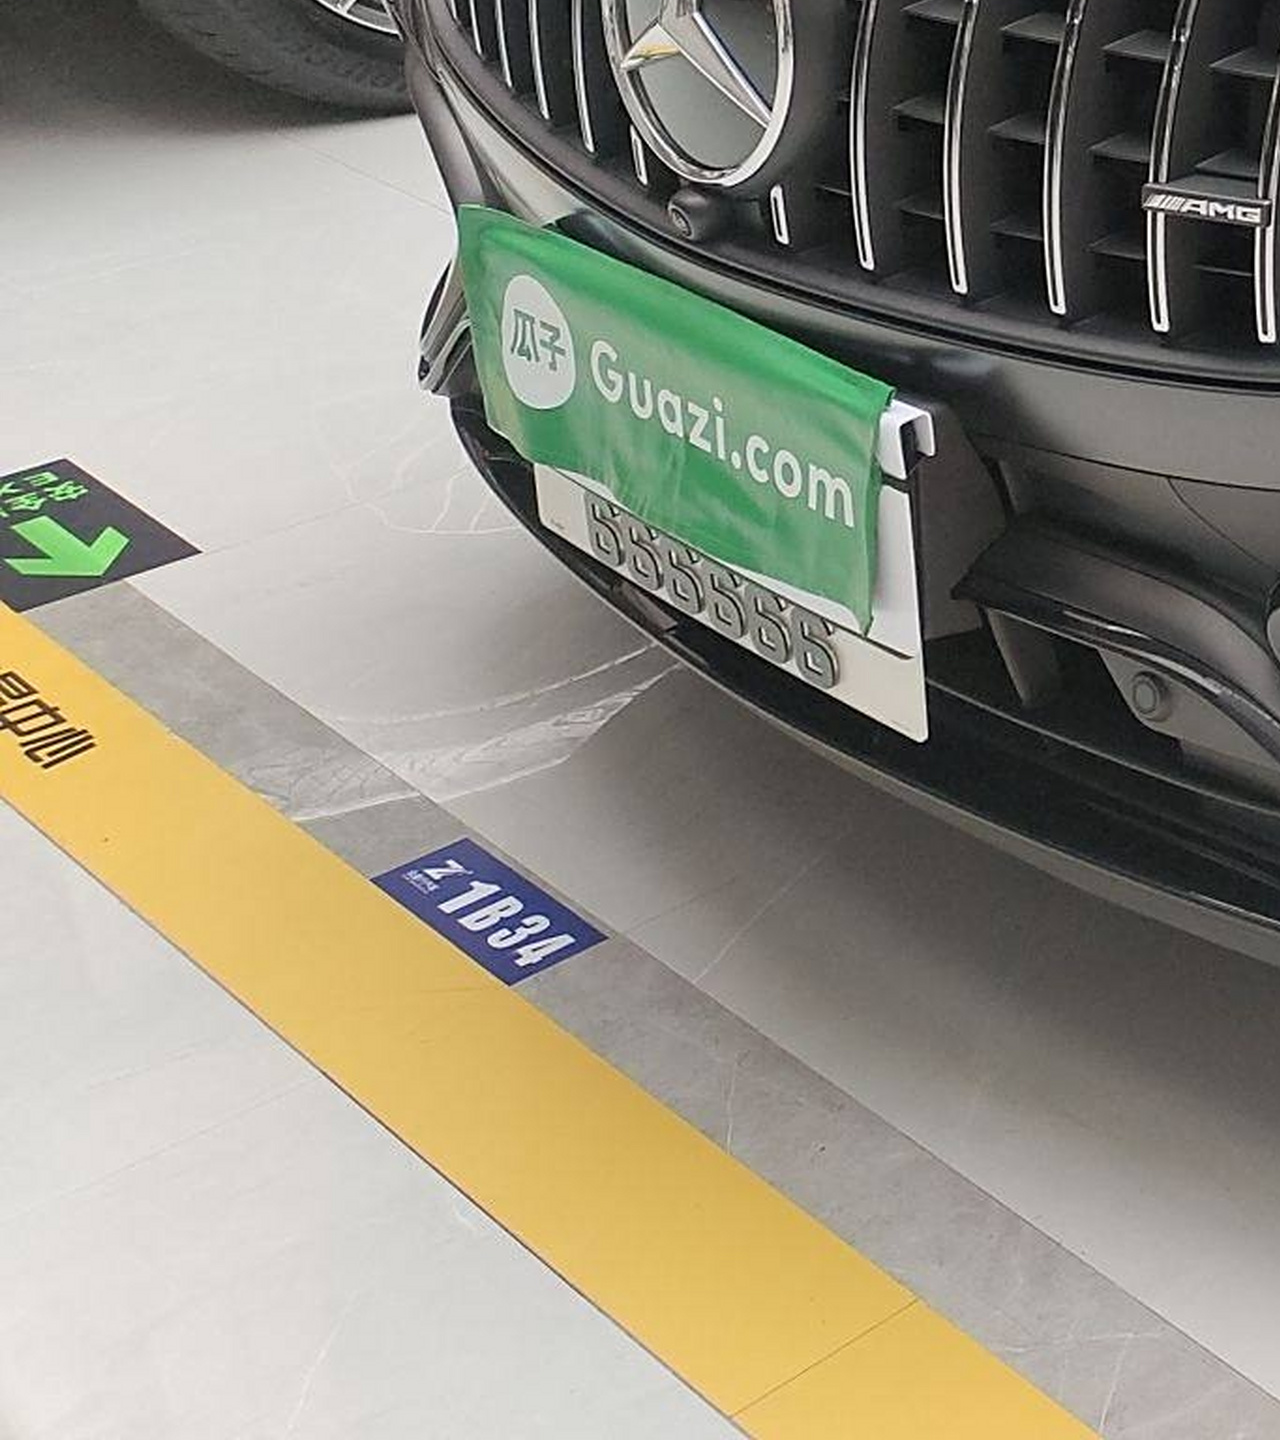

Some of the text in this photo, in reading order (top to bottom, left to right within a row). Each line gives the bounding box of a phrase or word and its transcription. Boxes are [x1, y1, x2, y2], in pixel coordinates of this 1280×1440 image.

[1181, 197, 1263, 224] AMG
[508, 306, 568, 372] 瓜子
[589, 338, 856, 529] Guazi.com
[437, 879, 577, 968] 1B34
